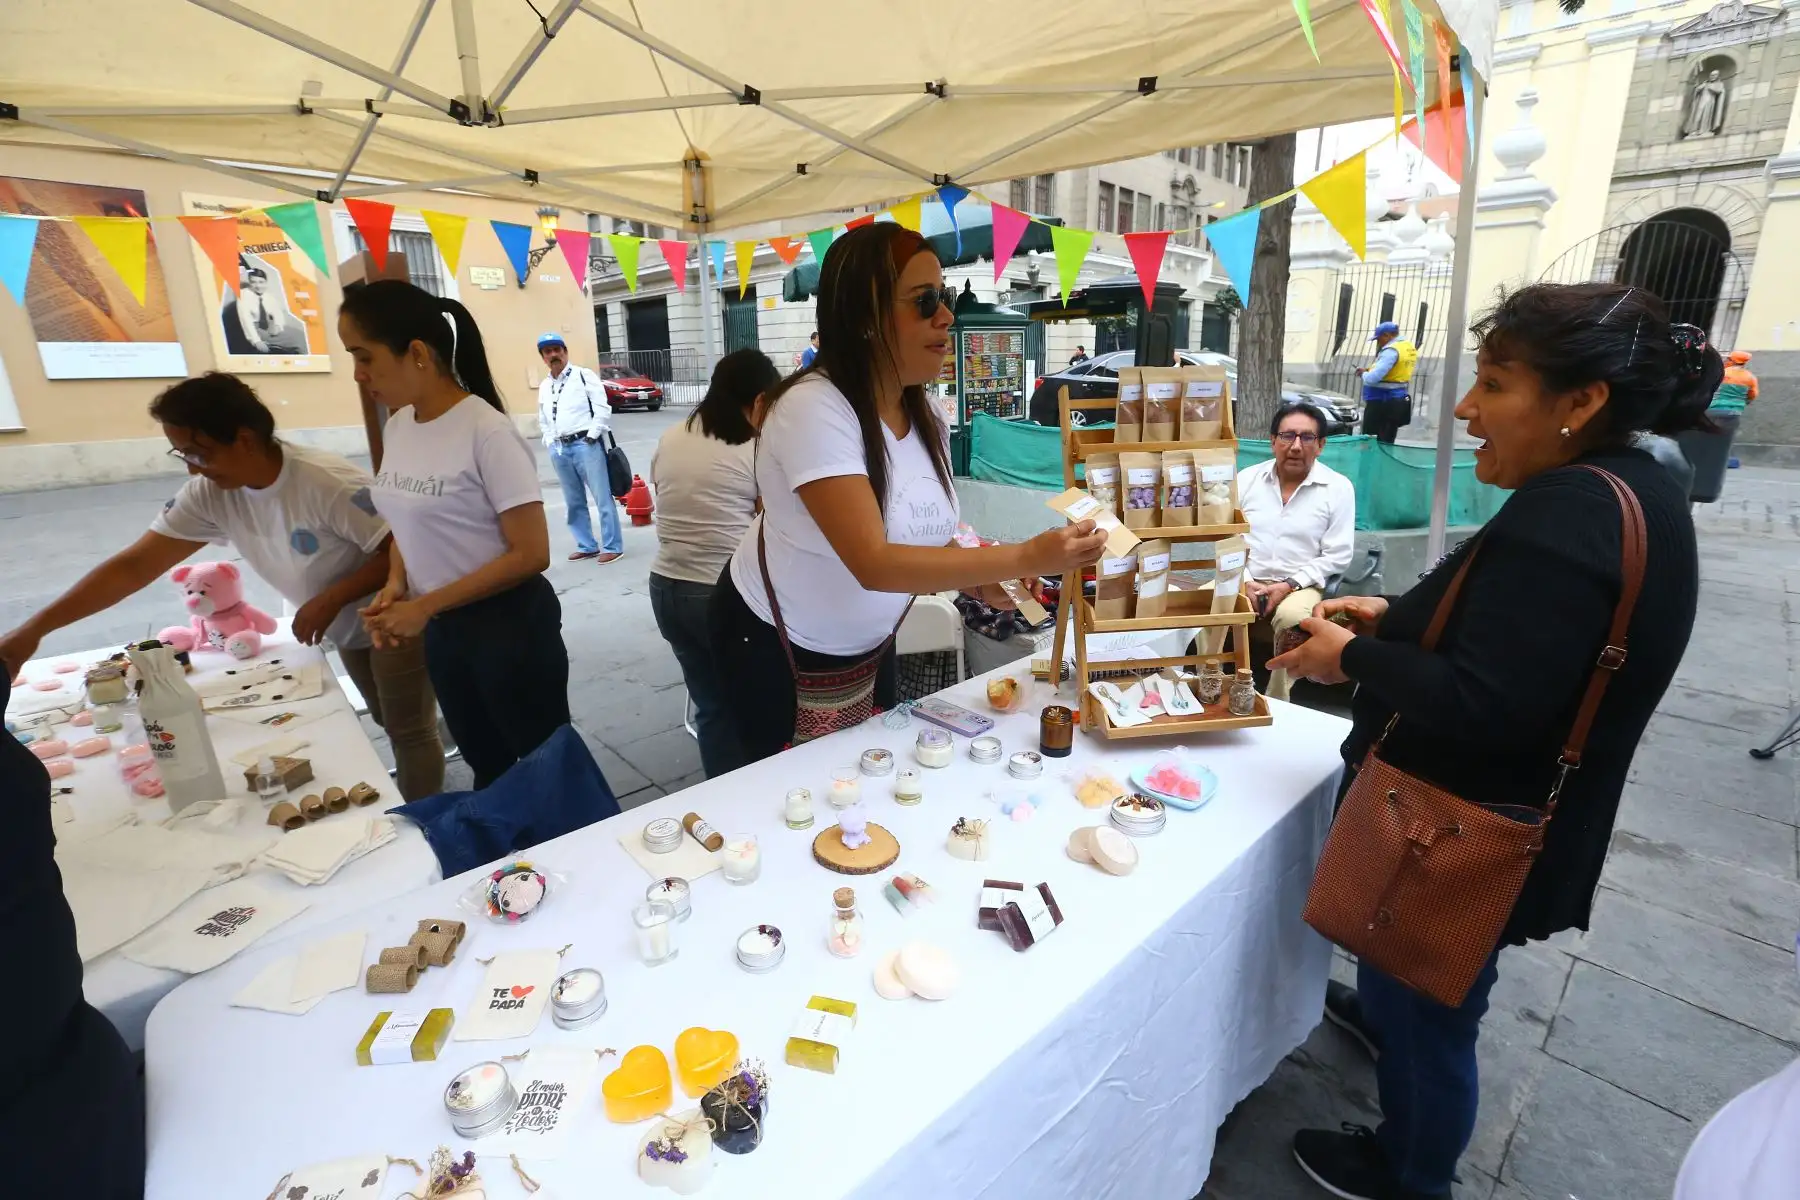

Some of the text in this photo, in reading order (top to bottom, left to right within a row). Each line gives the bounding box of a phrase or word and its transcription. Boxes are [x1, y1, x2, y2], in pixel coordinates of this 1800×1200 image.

[493, 988, 510, 998] TE
[489, 996, 526, 1009] PAPÁ
[526, 1080, 565, 1093] El mejor
[516, 1093, 567, 1110] PADRE
